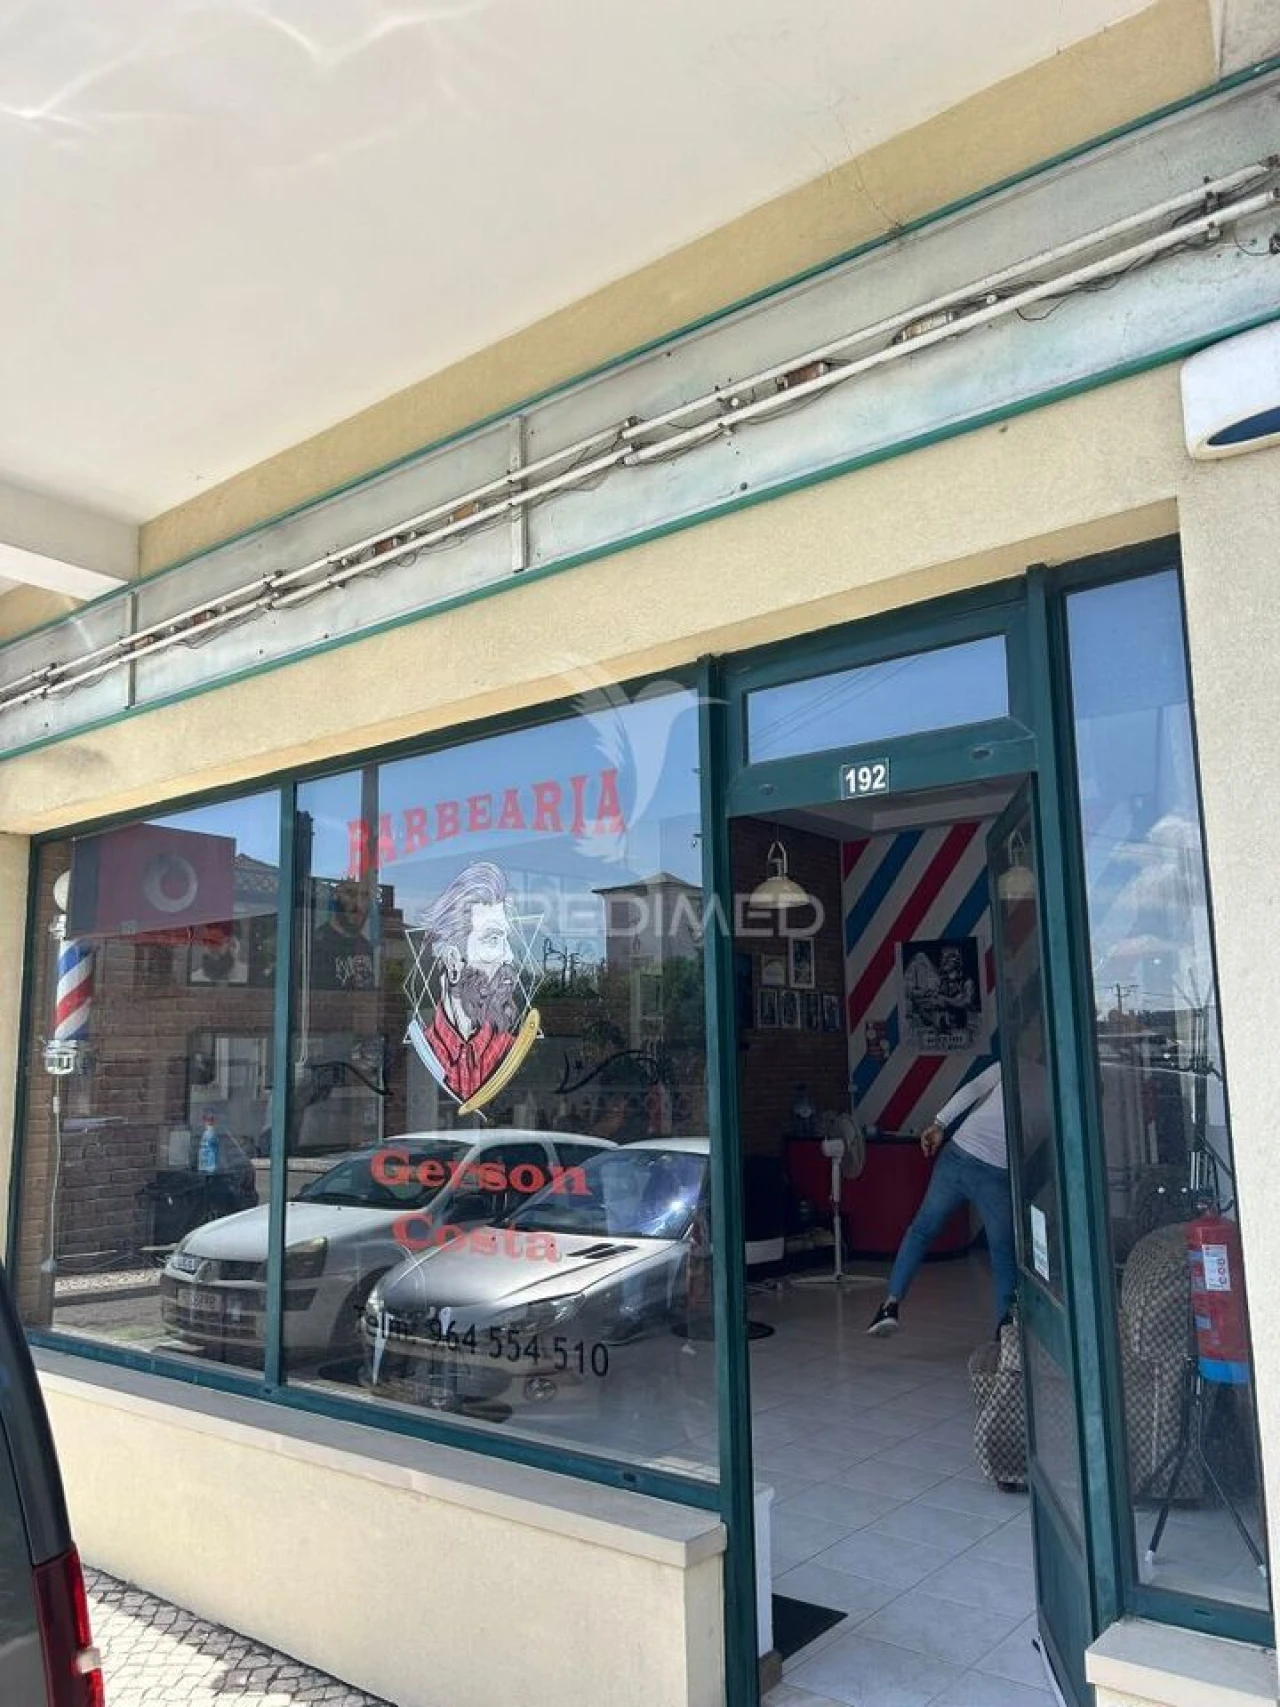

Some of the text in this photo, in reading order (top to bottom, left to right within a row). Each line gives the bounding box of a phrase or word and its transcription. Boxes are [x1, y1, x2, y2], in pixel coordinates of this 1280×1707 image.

[845, 765, 886, 793] 192
[347, 768, 627, 877] BARBEARIA
[370, 1148, 592, 1196] Gerson
[391, 1212, 563, 1263] Costa
[427, 1316, 477, 1354] 964
[488, 1325, 541, 1366] 554
[554, 1336, 609, 1377] 510
